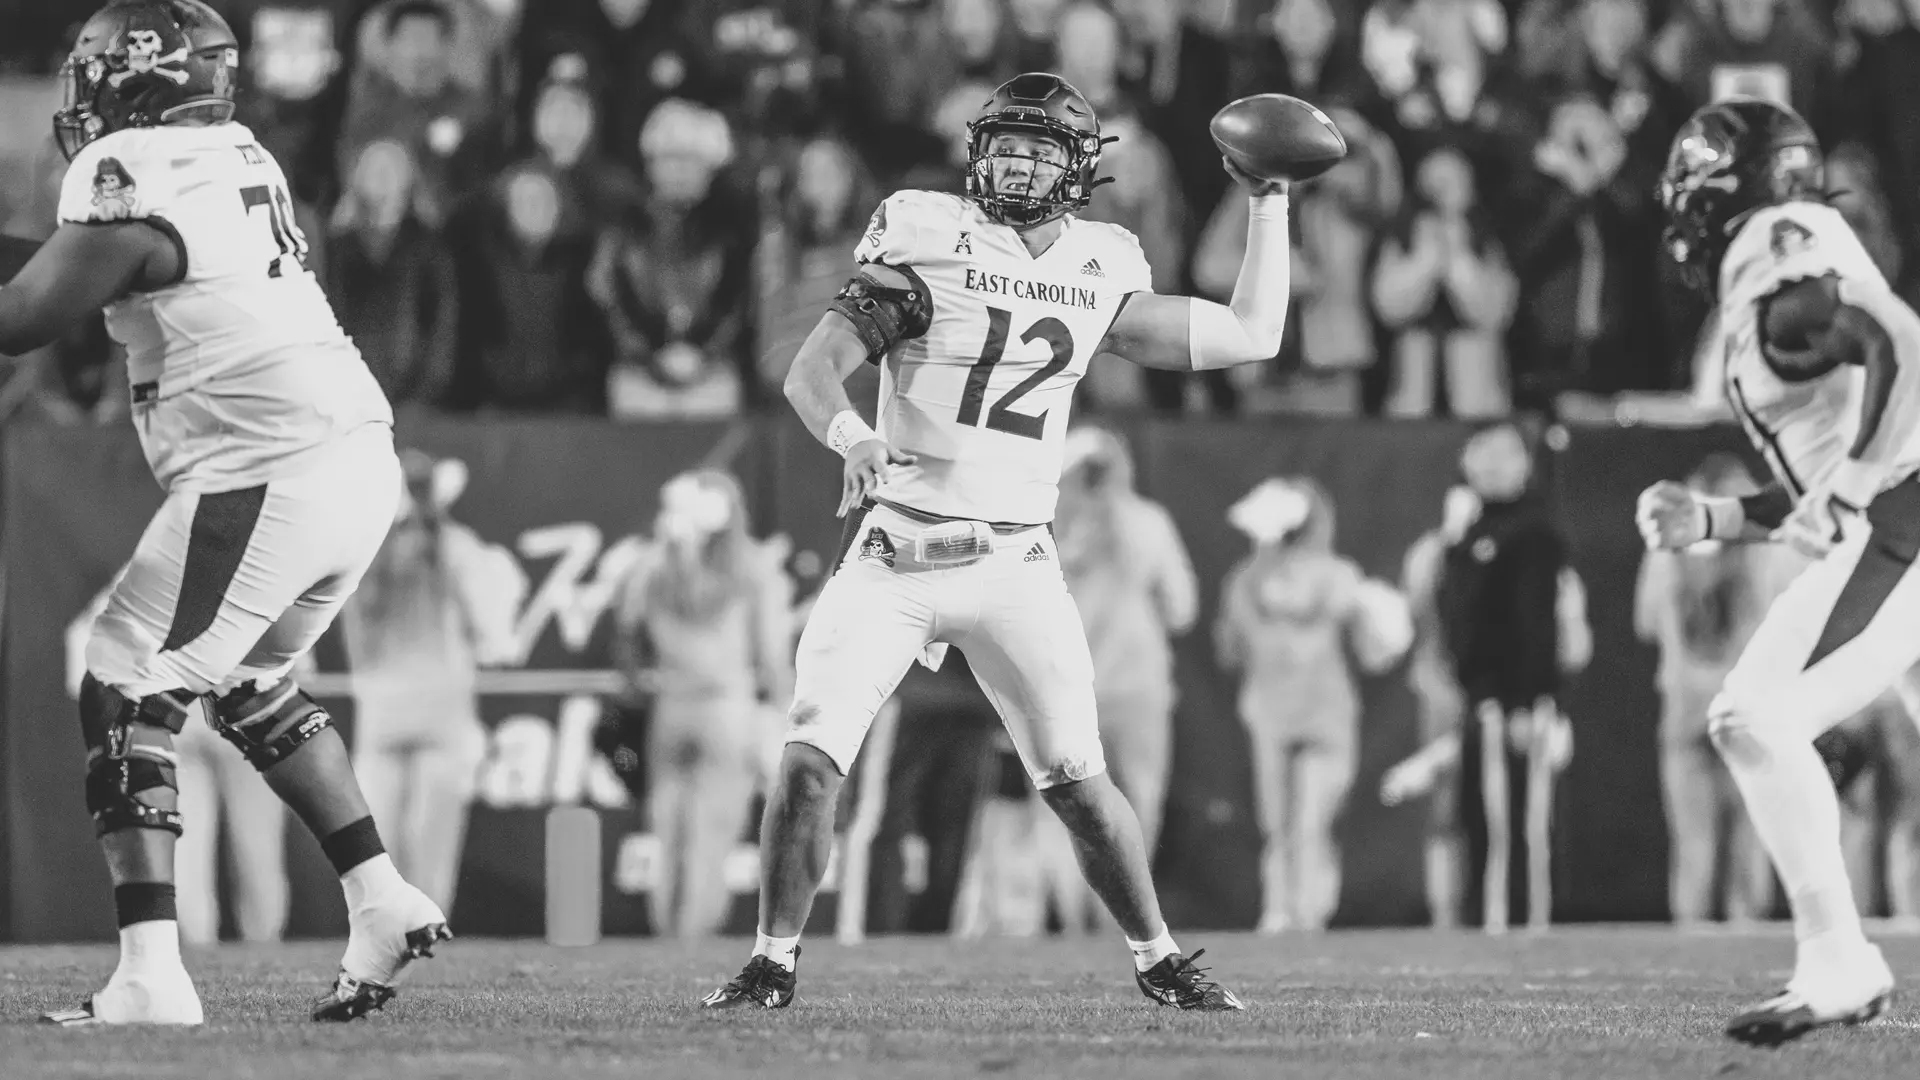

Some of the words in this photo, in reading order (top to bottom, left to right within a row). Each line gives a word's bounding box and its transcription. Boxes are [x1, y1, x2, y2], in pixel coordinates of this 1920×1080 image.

[964, 268, 1010, 295] EAST
[1013, 280, 1097, 310] CAROLINA
[1080, 267, 1105, 278] adidas
[956, 305, 1075, 441] 12
[1023, 554, 1050, 563] adidas
[483, 696, 632, 810] ak
